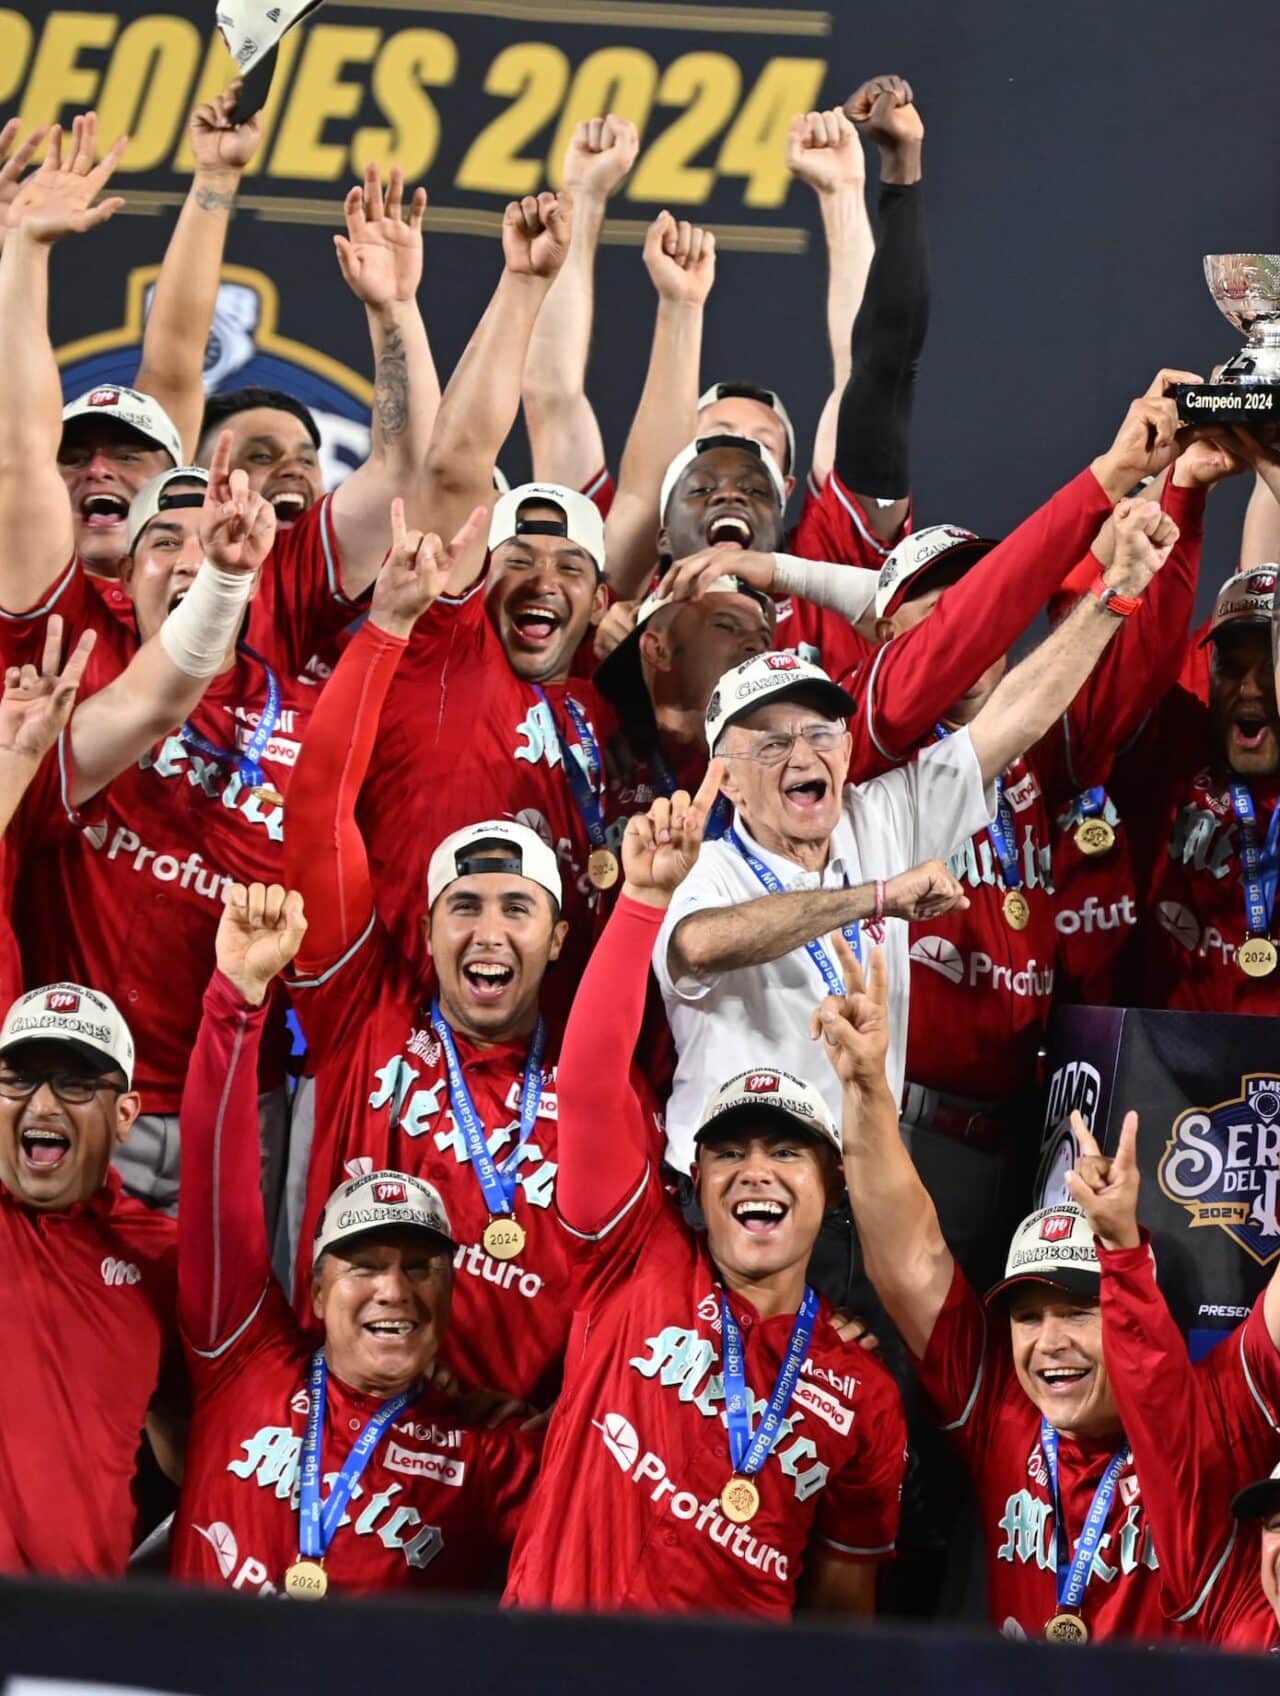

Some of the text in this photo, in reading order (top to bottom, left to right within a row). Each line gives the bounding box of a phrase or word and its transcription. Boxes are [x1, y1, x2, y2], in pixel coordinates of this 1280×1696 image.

[455, 43, 828, 208] 2024
[1186, 391, 1273, 411] Campeón 2024
[1235, 786, 1249, 814] Liga
[1249, 884, 1261, 902] de
[1244, 951, 1272, 964] 2024
[9, 1014, 112, 1043] CAMPEONES
[525, 1072, 540, 1122] Beisbol
[454, 1090, 484, 1156] Mexicana
[479, 1157, 496, 1189] Liga
[1222, 1171, 1261, 1193] DEL
[336, 1207, 442, 1230] CAMPEONES
[1198, 1207, 1244, 1220] 2024
[490, 1232, 519, 1246] 2024
[727, 1325, 742, 1377] Beisbol
[792, 1328, 808, 1353] Liga
[312, 1365, 323, 1387] de
[773, 1354, 804, 1413] Mexicana
[305, 1388, 321, 1452] Mexicana
[767, 1415, 780, 1432] de
[354, 1425, 379, 1457] Liga
[301, 1455, 317, 1488] Liga
[389, 1453, 457, 1479] Lenovo
[1083, 1527, 1098, 1545] de
[291, 1573, 321, 1591] 2024
[1066, 1552, 1092, 1606] Beisbol
